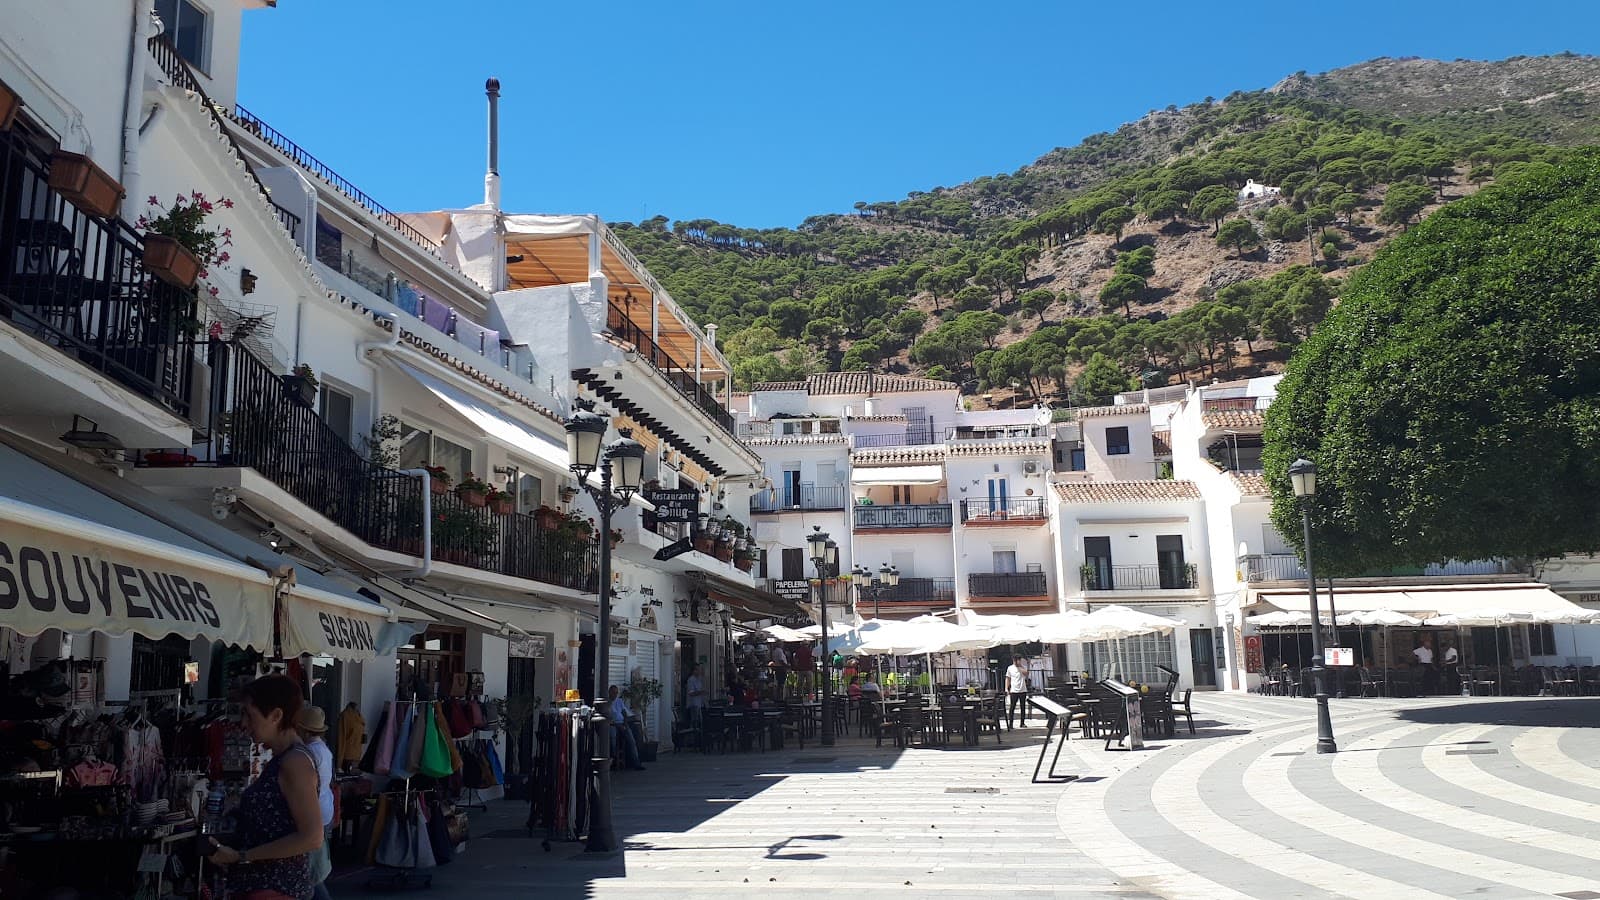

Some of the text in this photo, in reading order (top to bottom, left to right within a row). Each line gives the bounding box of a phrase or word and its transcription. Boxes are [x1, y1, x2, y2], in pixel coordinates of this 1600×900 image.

[651, 492, 696, 501] Restaurante
[656, 505, 689, 519] Snug
[0, 541, 221, 628] SOUVENIRS
[318, 611, 377, 651] SUSANA
